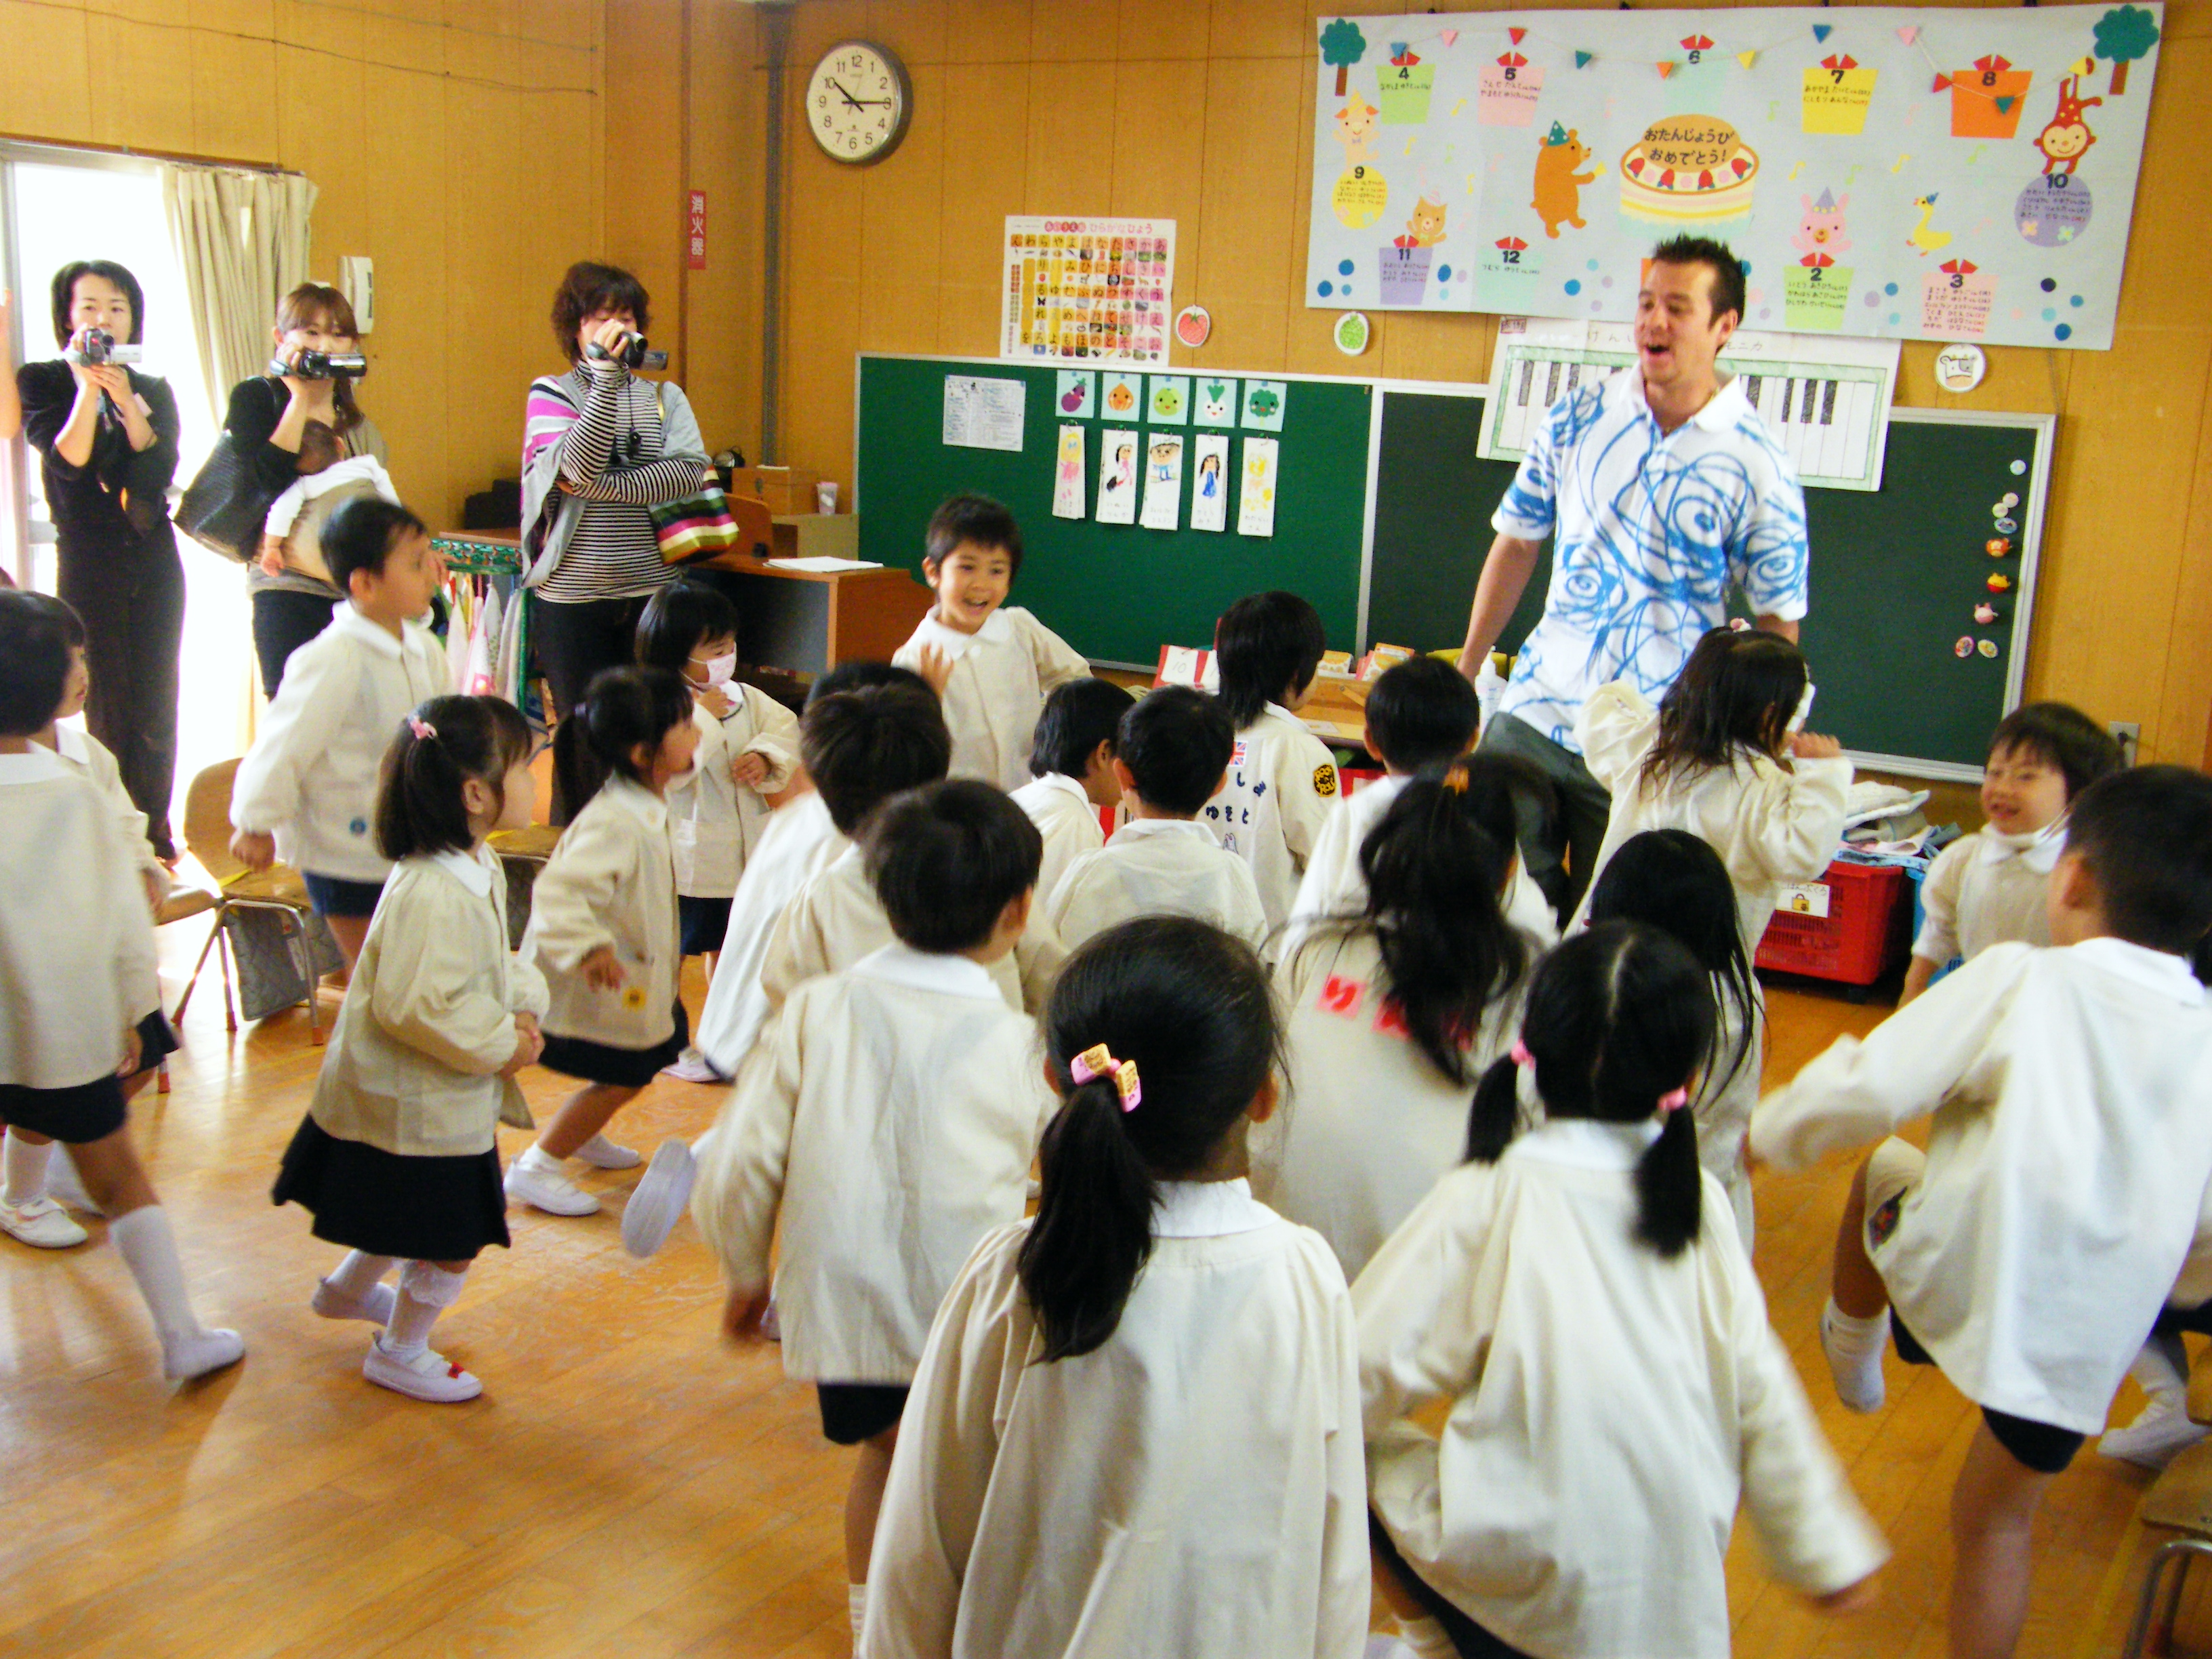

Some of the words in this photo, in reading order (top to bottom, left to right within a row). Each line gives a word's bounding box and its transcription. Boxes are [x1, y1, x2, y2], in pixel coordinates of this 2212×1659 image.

[851, 55, 863, 67] 12
[1689, 50, 1700, 64] 6
[837, 61, 845, 73] 11
[1399, 67, 1410, 79] 4
[1504, 67, 1516, 81] 5
[1831, 69, 1845, 84] 7
[1982, 71, 1996, 86] 8
[824, 77, 836, 89] 10
[880, 77, 888, 89] 2
[819, 96, 826, 108] 9
[824, 115, 832, 127] 8
[878, 118, 885, 129] 4
[836, 131, 842, 144] 7
[865, 132, 873, 145] 5
[1644, 127, 1735, 144] おたんじょうび
[849, 138, 857, 150] 6
[1355, 166, 1364, 179] 9
[2047, 173, 2068, 188] 10
[691, 194, 704, 256] 消火器
[1399, 248, 1411, 260] 11
[1502, 250, 1520, 264] 12
[1810, 268, 1822, 281] 2
[1950, 274, 1963, 288] 3
